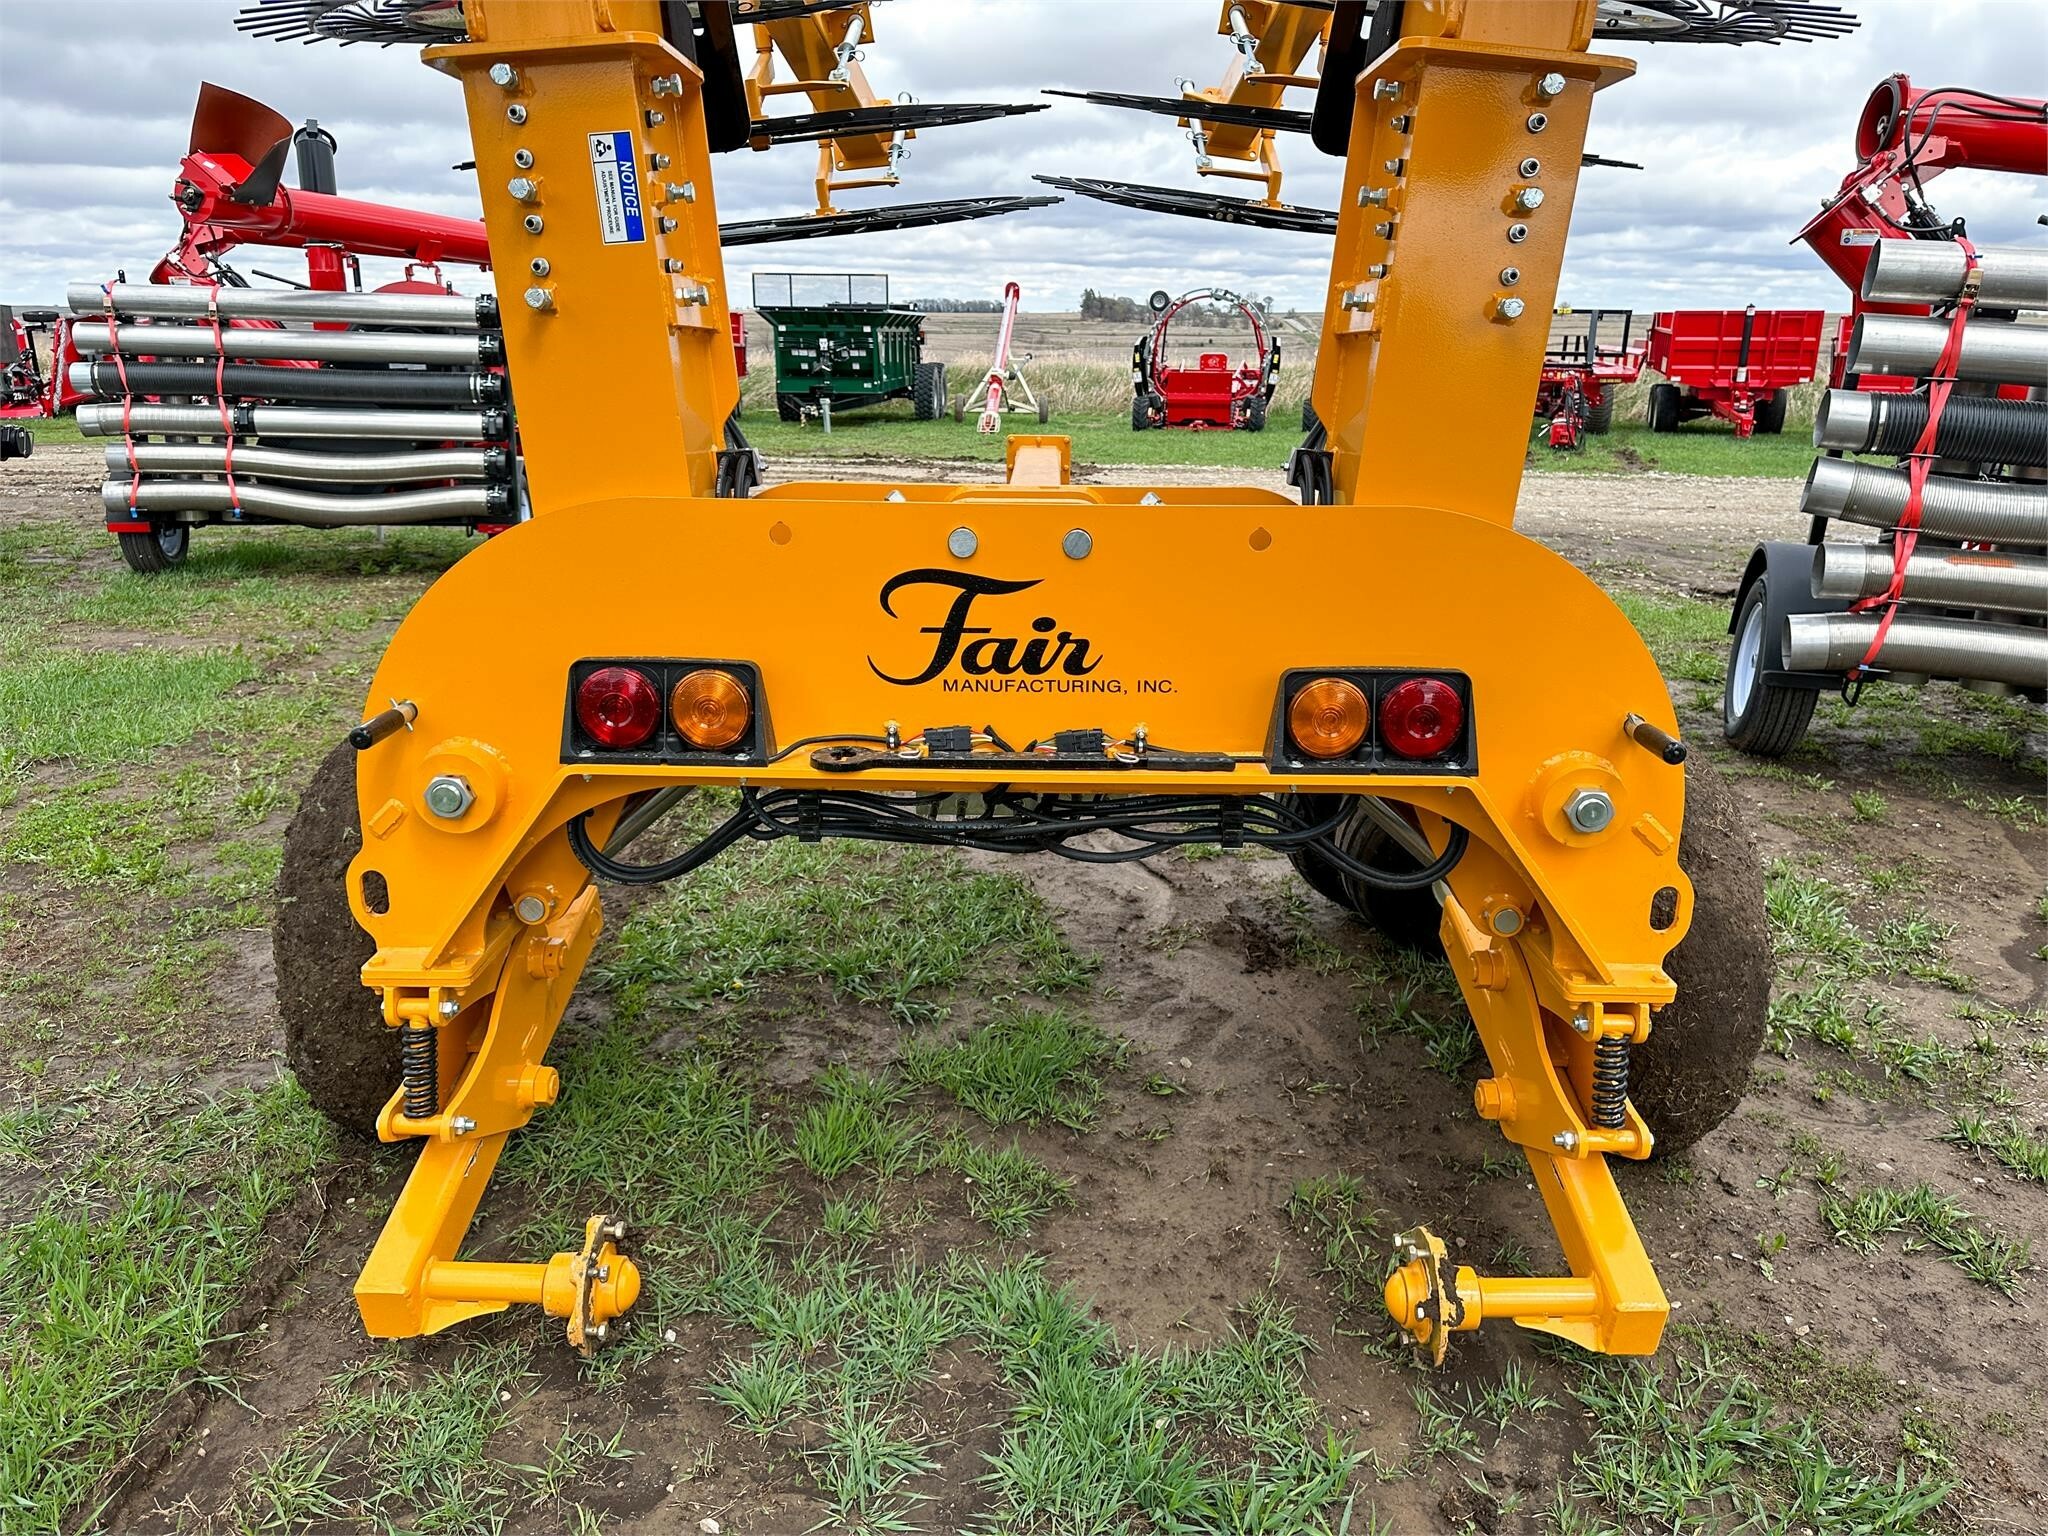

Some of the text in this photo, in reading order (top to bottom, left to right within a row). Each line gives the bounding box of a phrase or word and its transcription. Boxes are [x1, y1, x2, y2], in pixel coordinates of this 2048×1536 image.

[601, 171, 610, 204] ADJUSTMENT
[620, 161, 639, 217] NOTICE
[866, 568, 1104, 686] Fair
[943, 679, 1179, 696] MANUFACTURING, INC.
